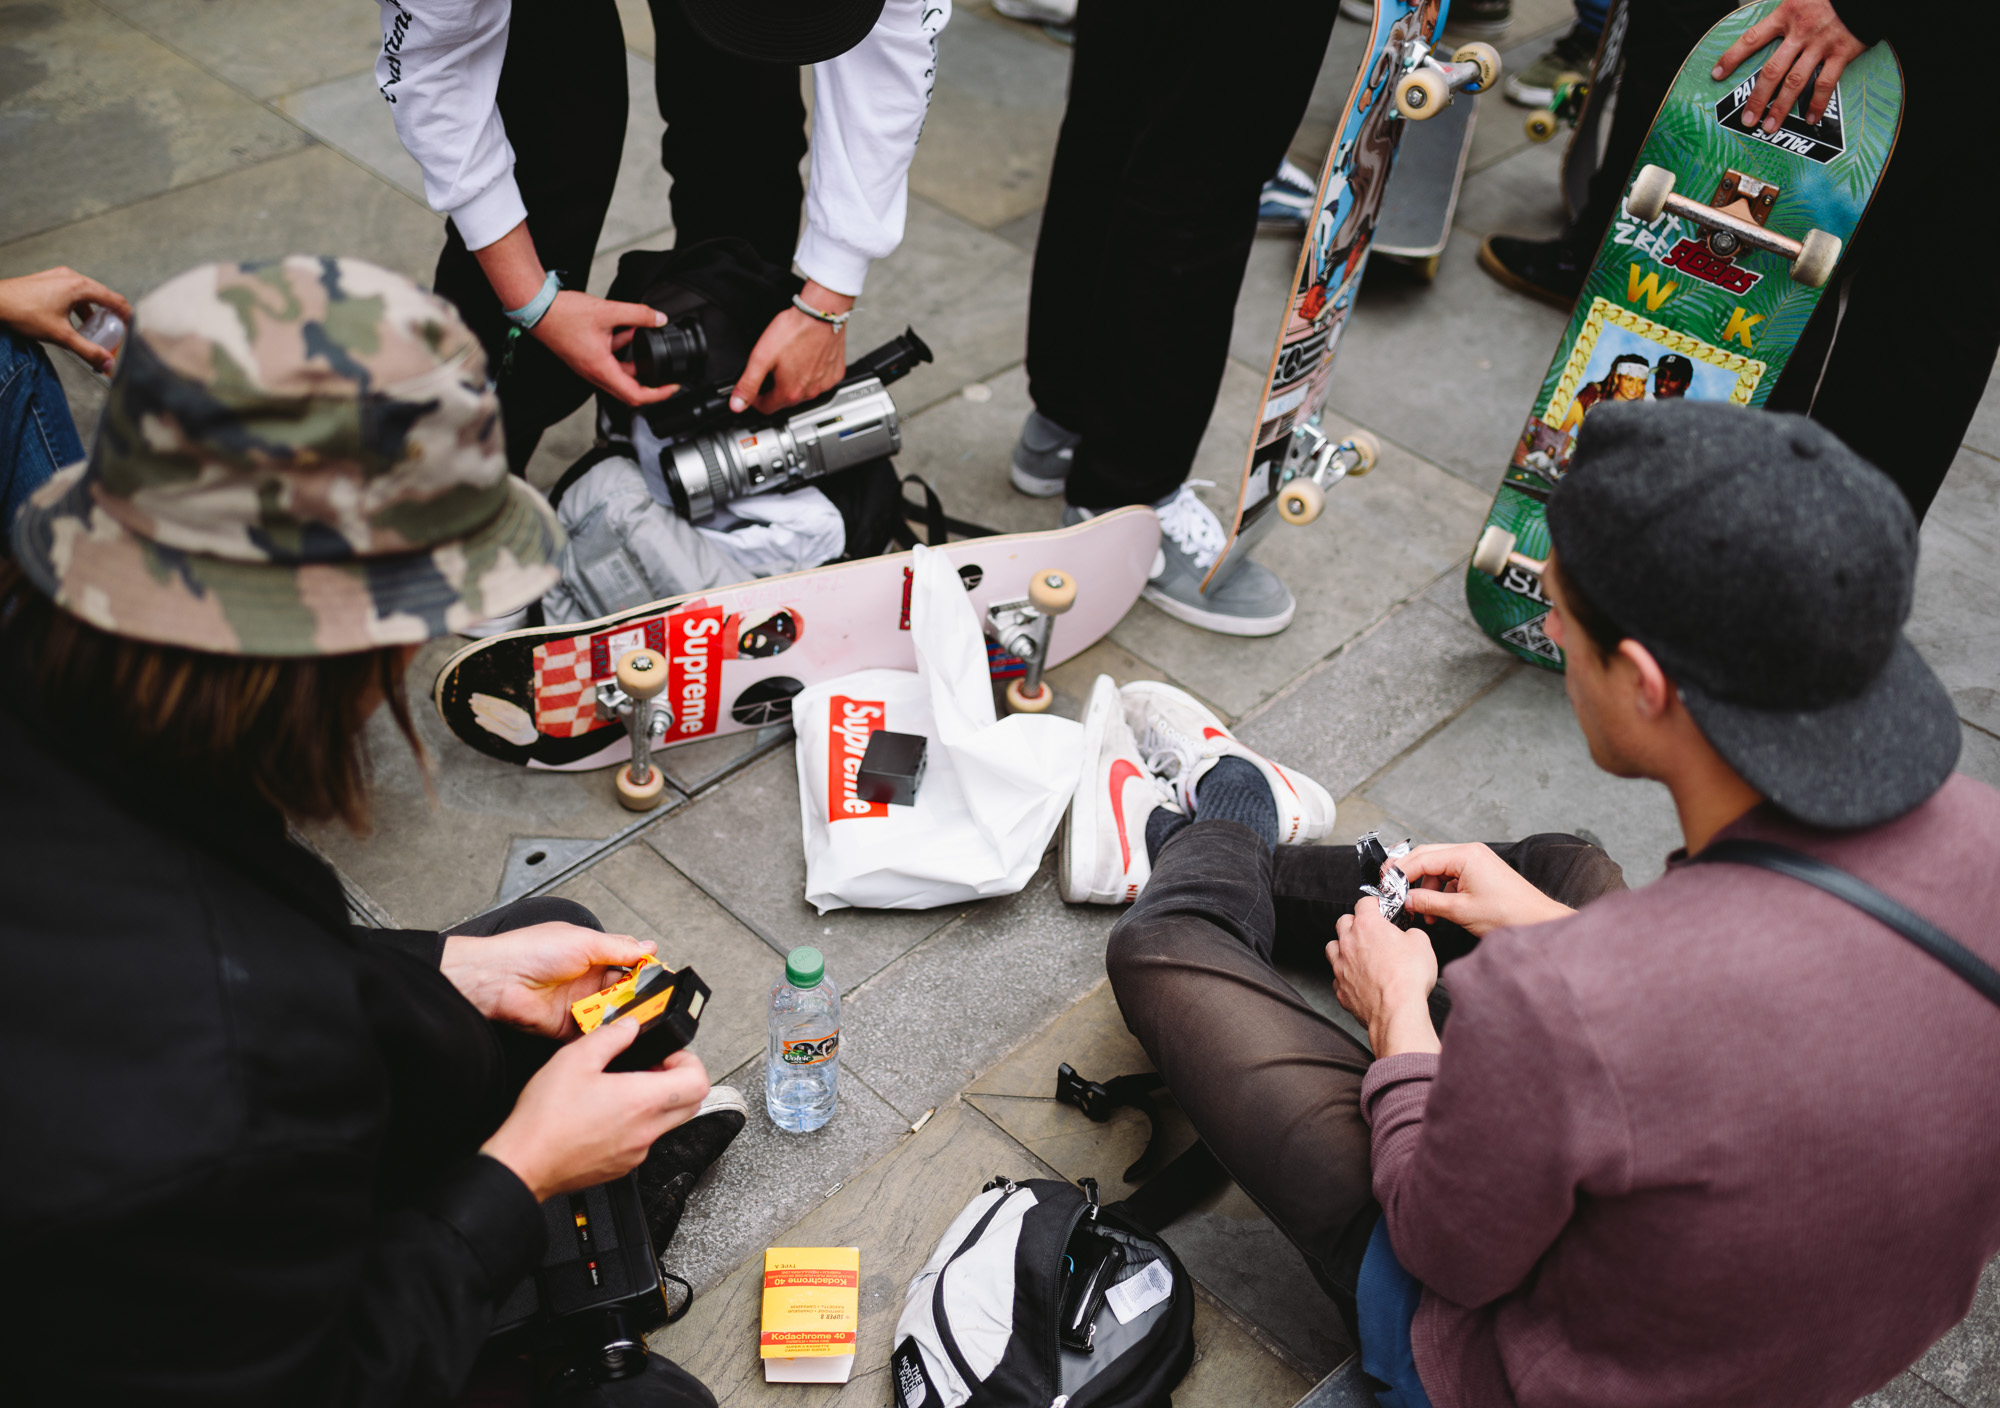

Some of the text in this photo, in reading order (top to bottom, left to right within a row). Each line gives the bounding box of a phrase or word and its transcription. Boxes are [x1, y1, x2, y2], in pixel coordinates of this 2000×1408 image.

[673, 617, 721, 734] Supreme
[774, 1277, 847, 1286] Kodachrome 40
[771, 1332, 846, 1341] Kodachrome 40
[899, 1369, 910, 1396] FACE
[901, 1355, 917, 1390] NORTH
[911, 1363, 924, 1386] THE
